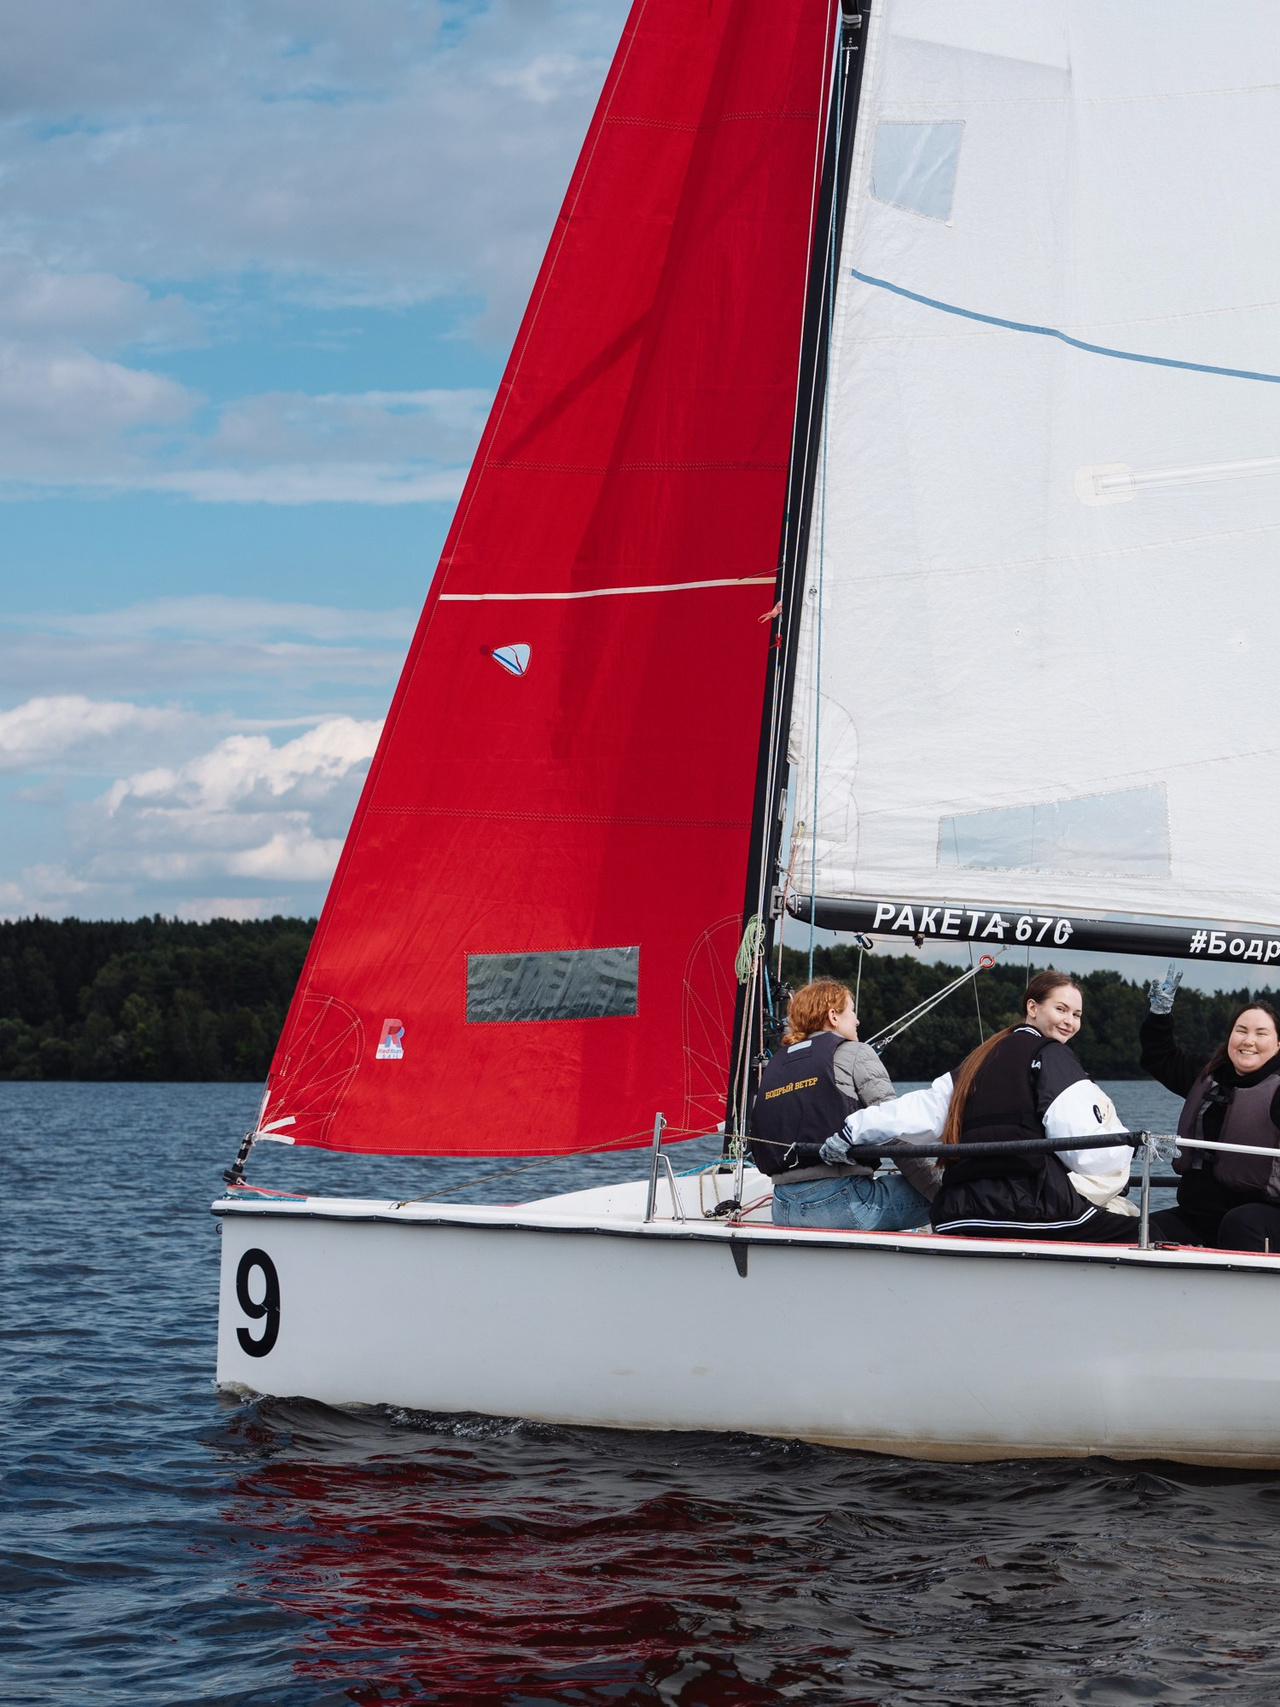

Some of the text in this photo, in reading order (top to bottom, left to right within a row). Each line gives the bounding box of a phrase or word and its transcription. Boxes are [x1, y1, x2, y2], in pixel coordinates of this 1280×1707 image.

[873, 903, 1072, 945] РАКЕТА 670
[765, 1076, 818, 1100] БОДРЫЙ ВЕТЕР
[236, 1248, 281, 1358] 9
